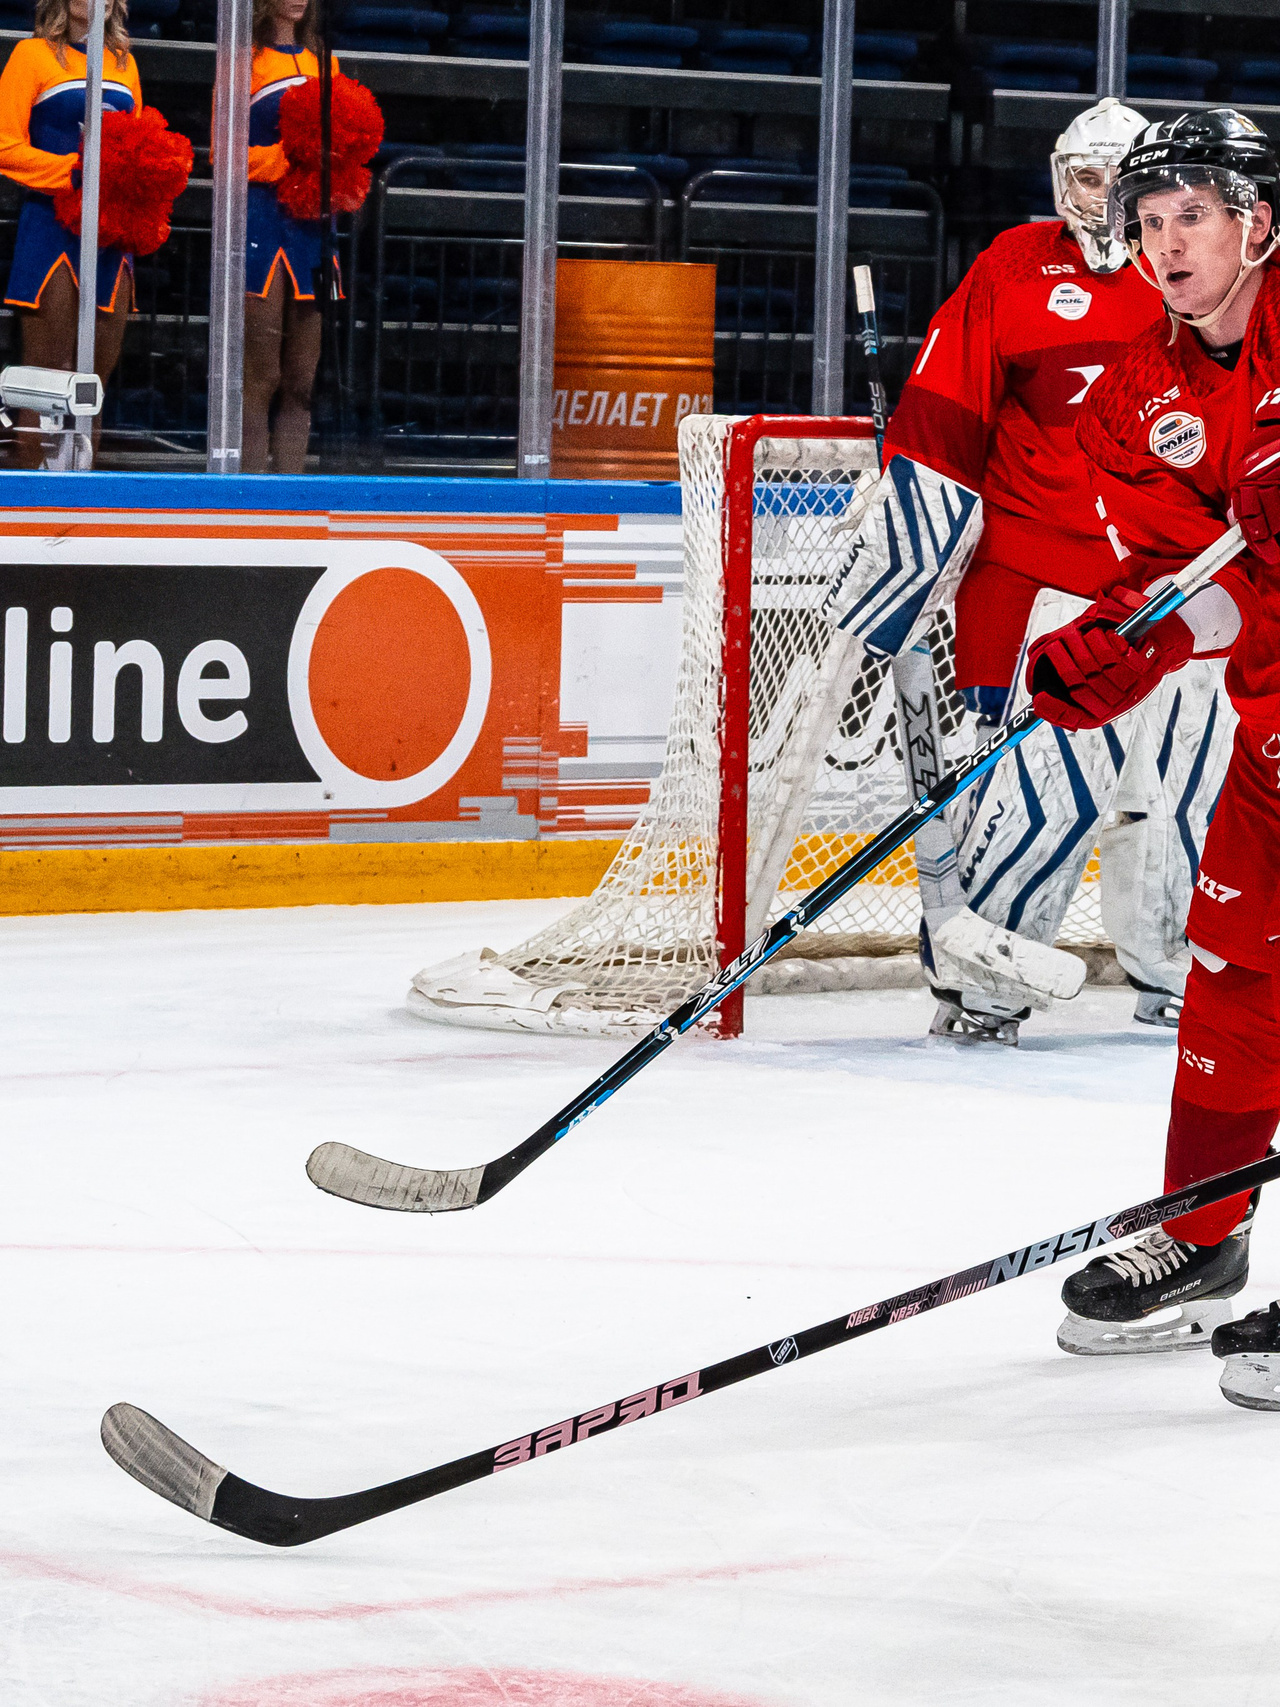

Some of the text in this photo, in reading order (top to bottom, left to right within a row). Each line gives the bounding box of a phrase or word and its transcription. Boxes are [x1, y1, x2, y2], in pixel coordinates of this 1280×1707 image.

[1129, 148, 1170, 167] CCM
[552, 389, 668, 430] ДЕЛАЕТ
[869, 382, 885, 429] PRO
[1158, 428, 1200, 454] MHL
[3, 606, 251, 743] line
[955, 707, 1036, 781] PRO ON
[1197, 869, 1242, 903] X17
[986, 1213, 1119, 1287] NBSK
[1160, 1278, 1202, 1301] BAUER
[493, 1370, 704, 1473] ЗАРЯД
